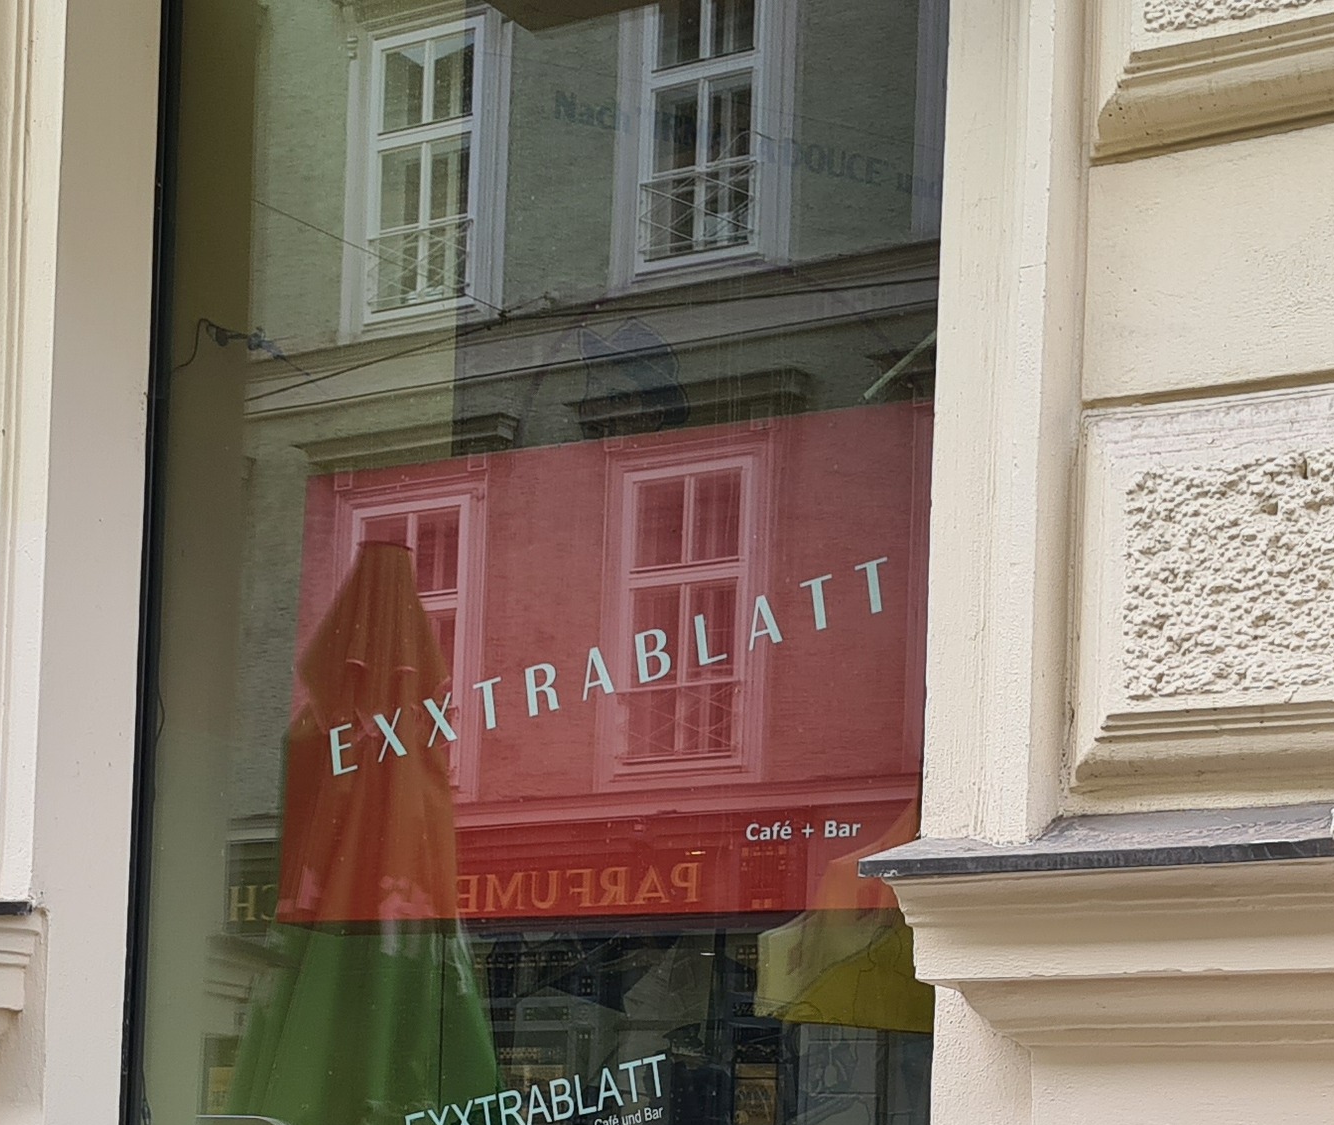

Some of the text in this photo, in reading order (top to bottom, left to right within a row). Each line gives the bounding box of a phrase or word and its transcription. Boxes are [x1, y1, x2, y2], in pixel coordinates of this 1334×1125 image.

[329, 556, 889, 777] EXXTRABLATT
[746, 822, 793, 842] Café
[823, 820, 862, 840] Bar
[644, 1105, 665, 1122] Bar
